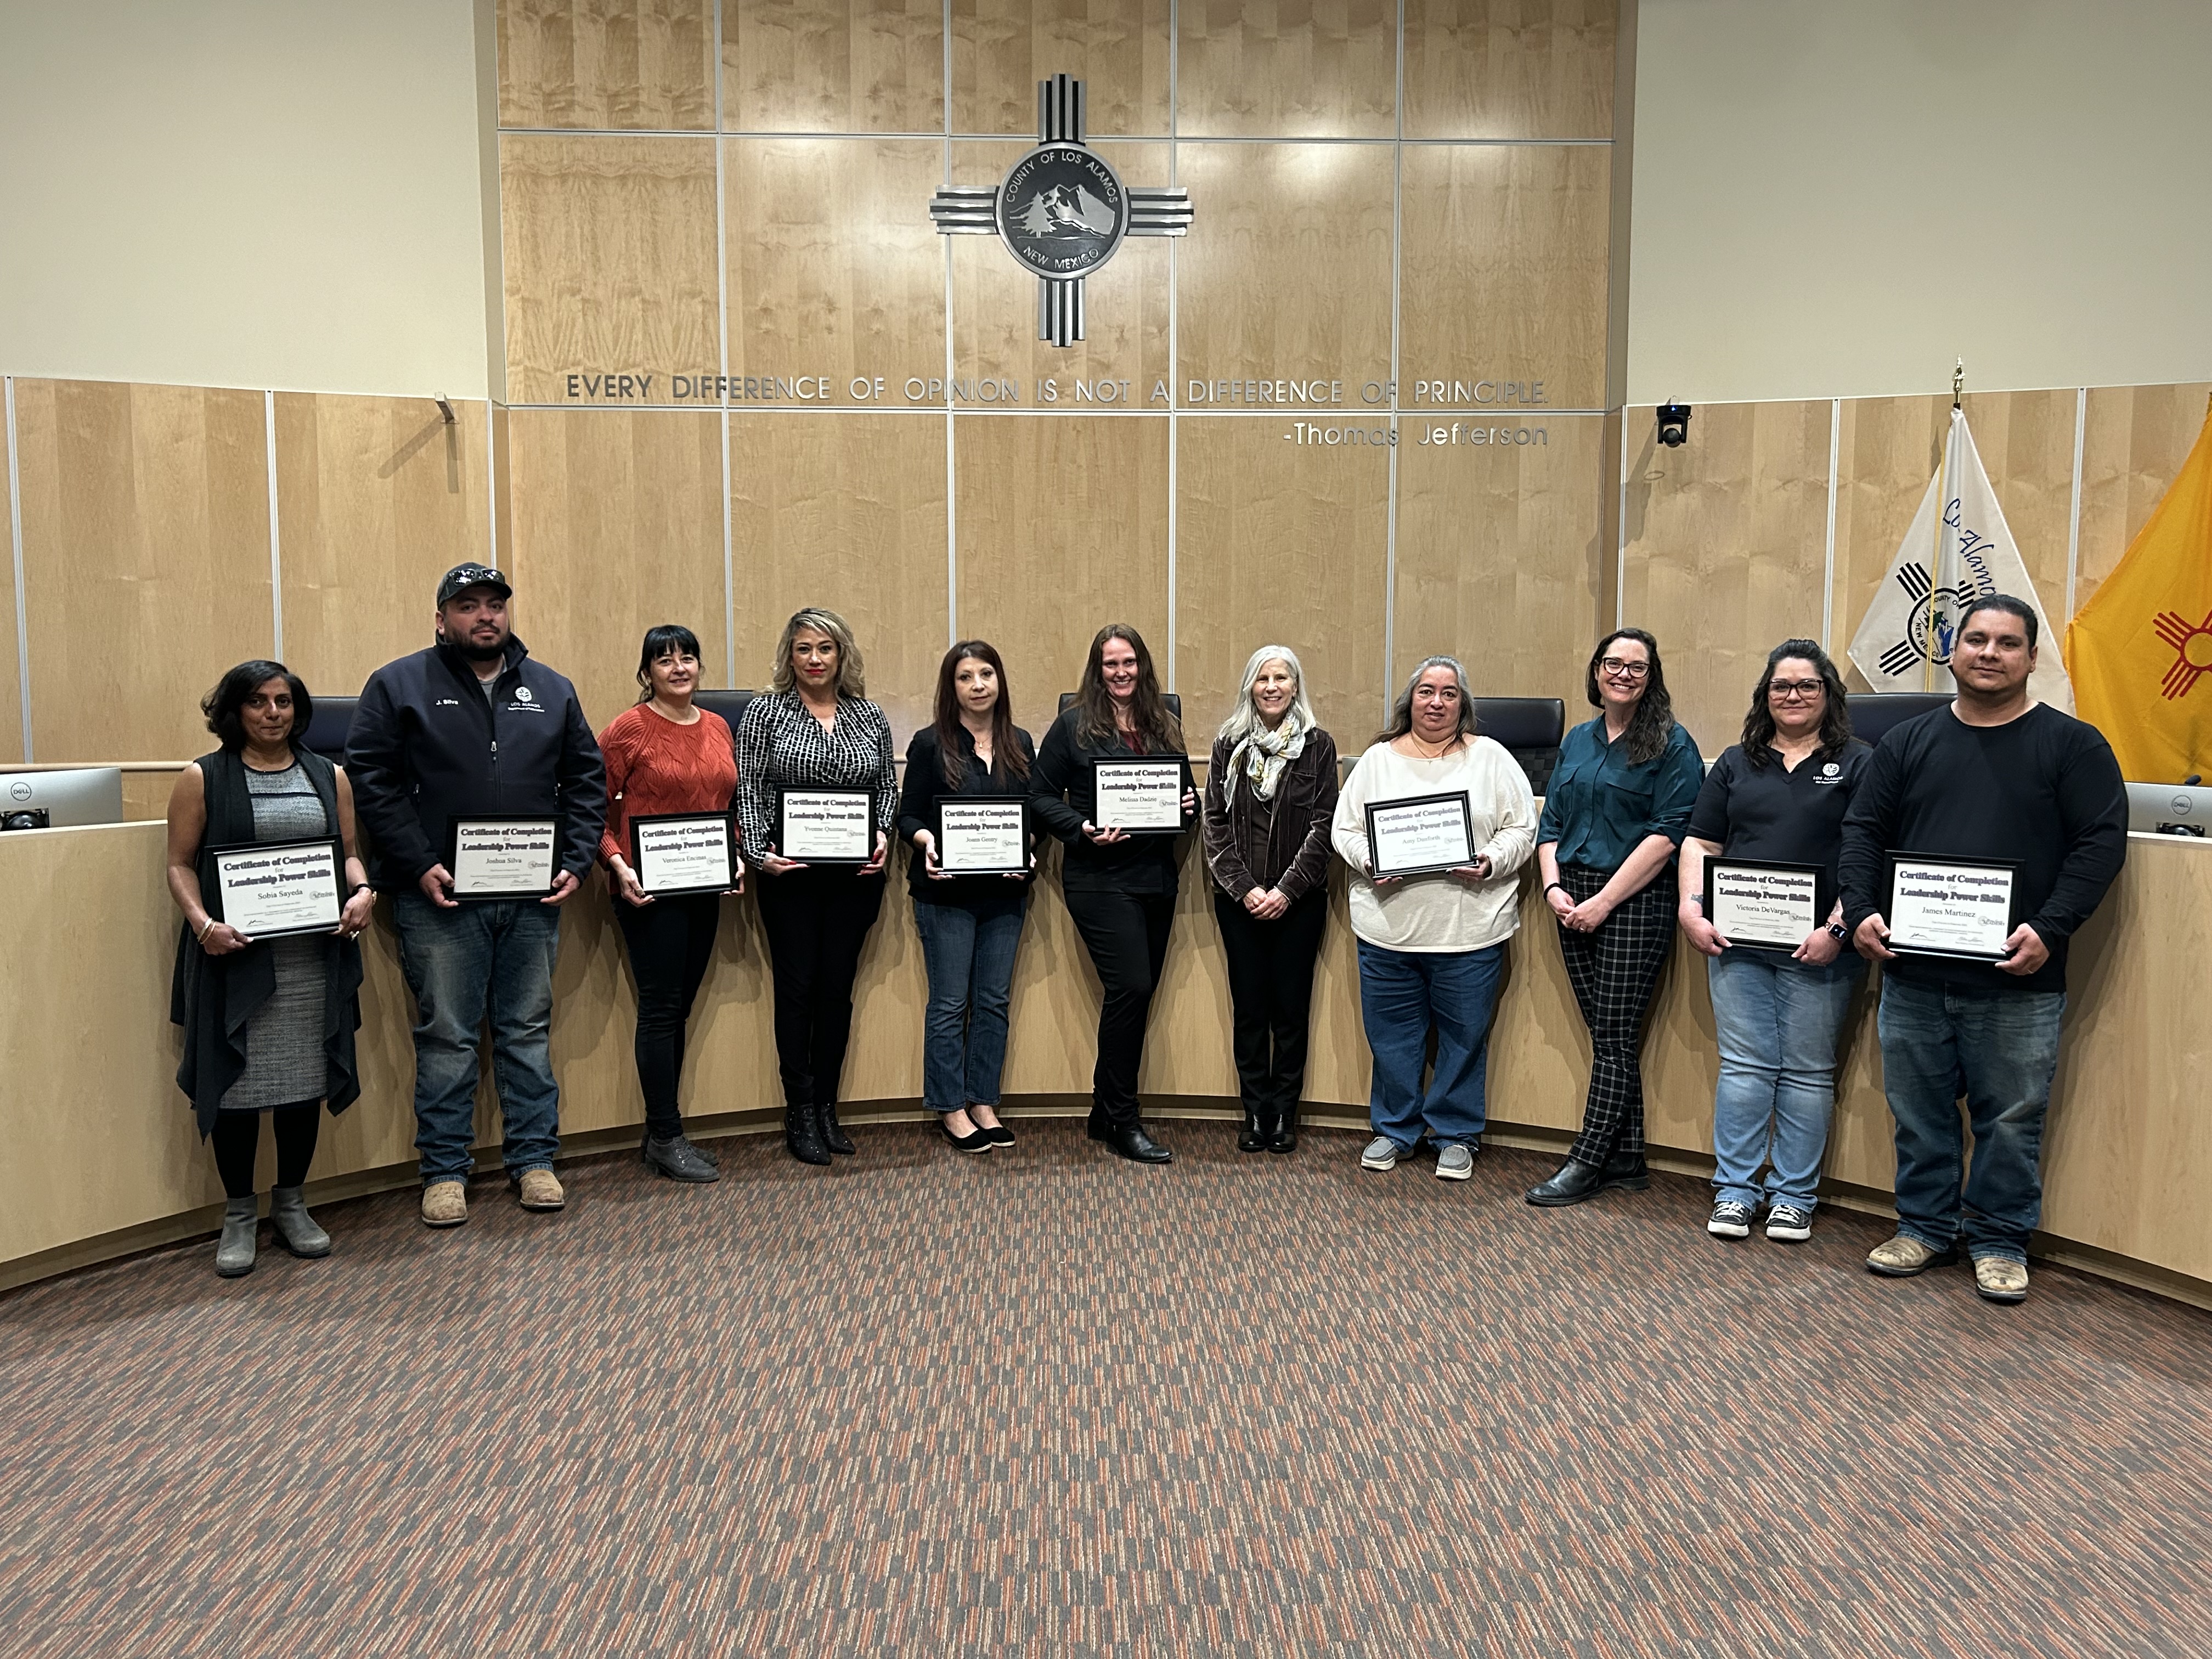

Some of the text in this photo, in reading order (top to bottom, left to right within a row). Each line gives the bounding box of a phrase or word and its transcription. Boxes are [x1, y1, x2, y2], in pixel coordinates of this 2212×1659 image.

[1007, 151, 1118, 203] COUNTY OF LOS ALAMOS
[1024, 246, 1098, 269] NEW MEXICO
[567, 375, 1548, 403] EVERY DIFFERENCE OF OPINION IS NOT A DIFFERENCE OF PRINCIPLE.
[1418, 424, 1548, 445] Jefferson
[1960, 529, 1996, 595] Alamo
[1919, 640, 1939, 657] MECO
[1378, 814, 1413, 822] Certificate
[1423, 808, 1460, 816] Completion
[687, 826, 723, 834] Completion
[1381, 825, 1418, 834] Leadership
[462, 843, 504, 851] Leadership
[645, 843, 682, 851] Leadership
[224, 860, 270, 871] Certificate
[283, 854, 331, 865] Completion
[228, 875, 277, 887] Leadership
[279, 872, 306, 882] Power
[1718, 873, 1757, 883] Certificate
[1768, 877, 1812, 887] Completion
[1900, 871, 1944, 881] Certificate
[1957, 875, 2008, 886] Completion
[258, 890, 276, 900] Sobia
[279, 889, 303, 898] Sayeda
[1719, 888, 1762, 899] Leadership
[1763, 891, 1787, 900] Power
[1900, 888, 1948, 900] Leadership
[1950, 891, 1978, 901] Power
[1945, 909, 1976, 917] Martinez
